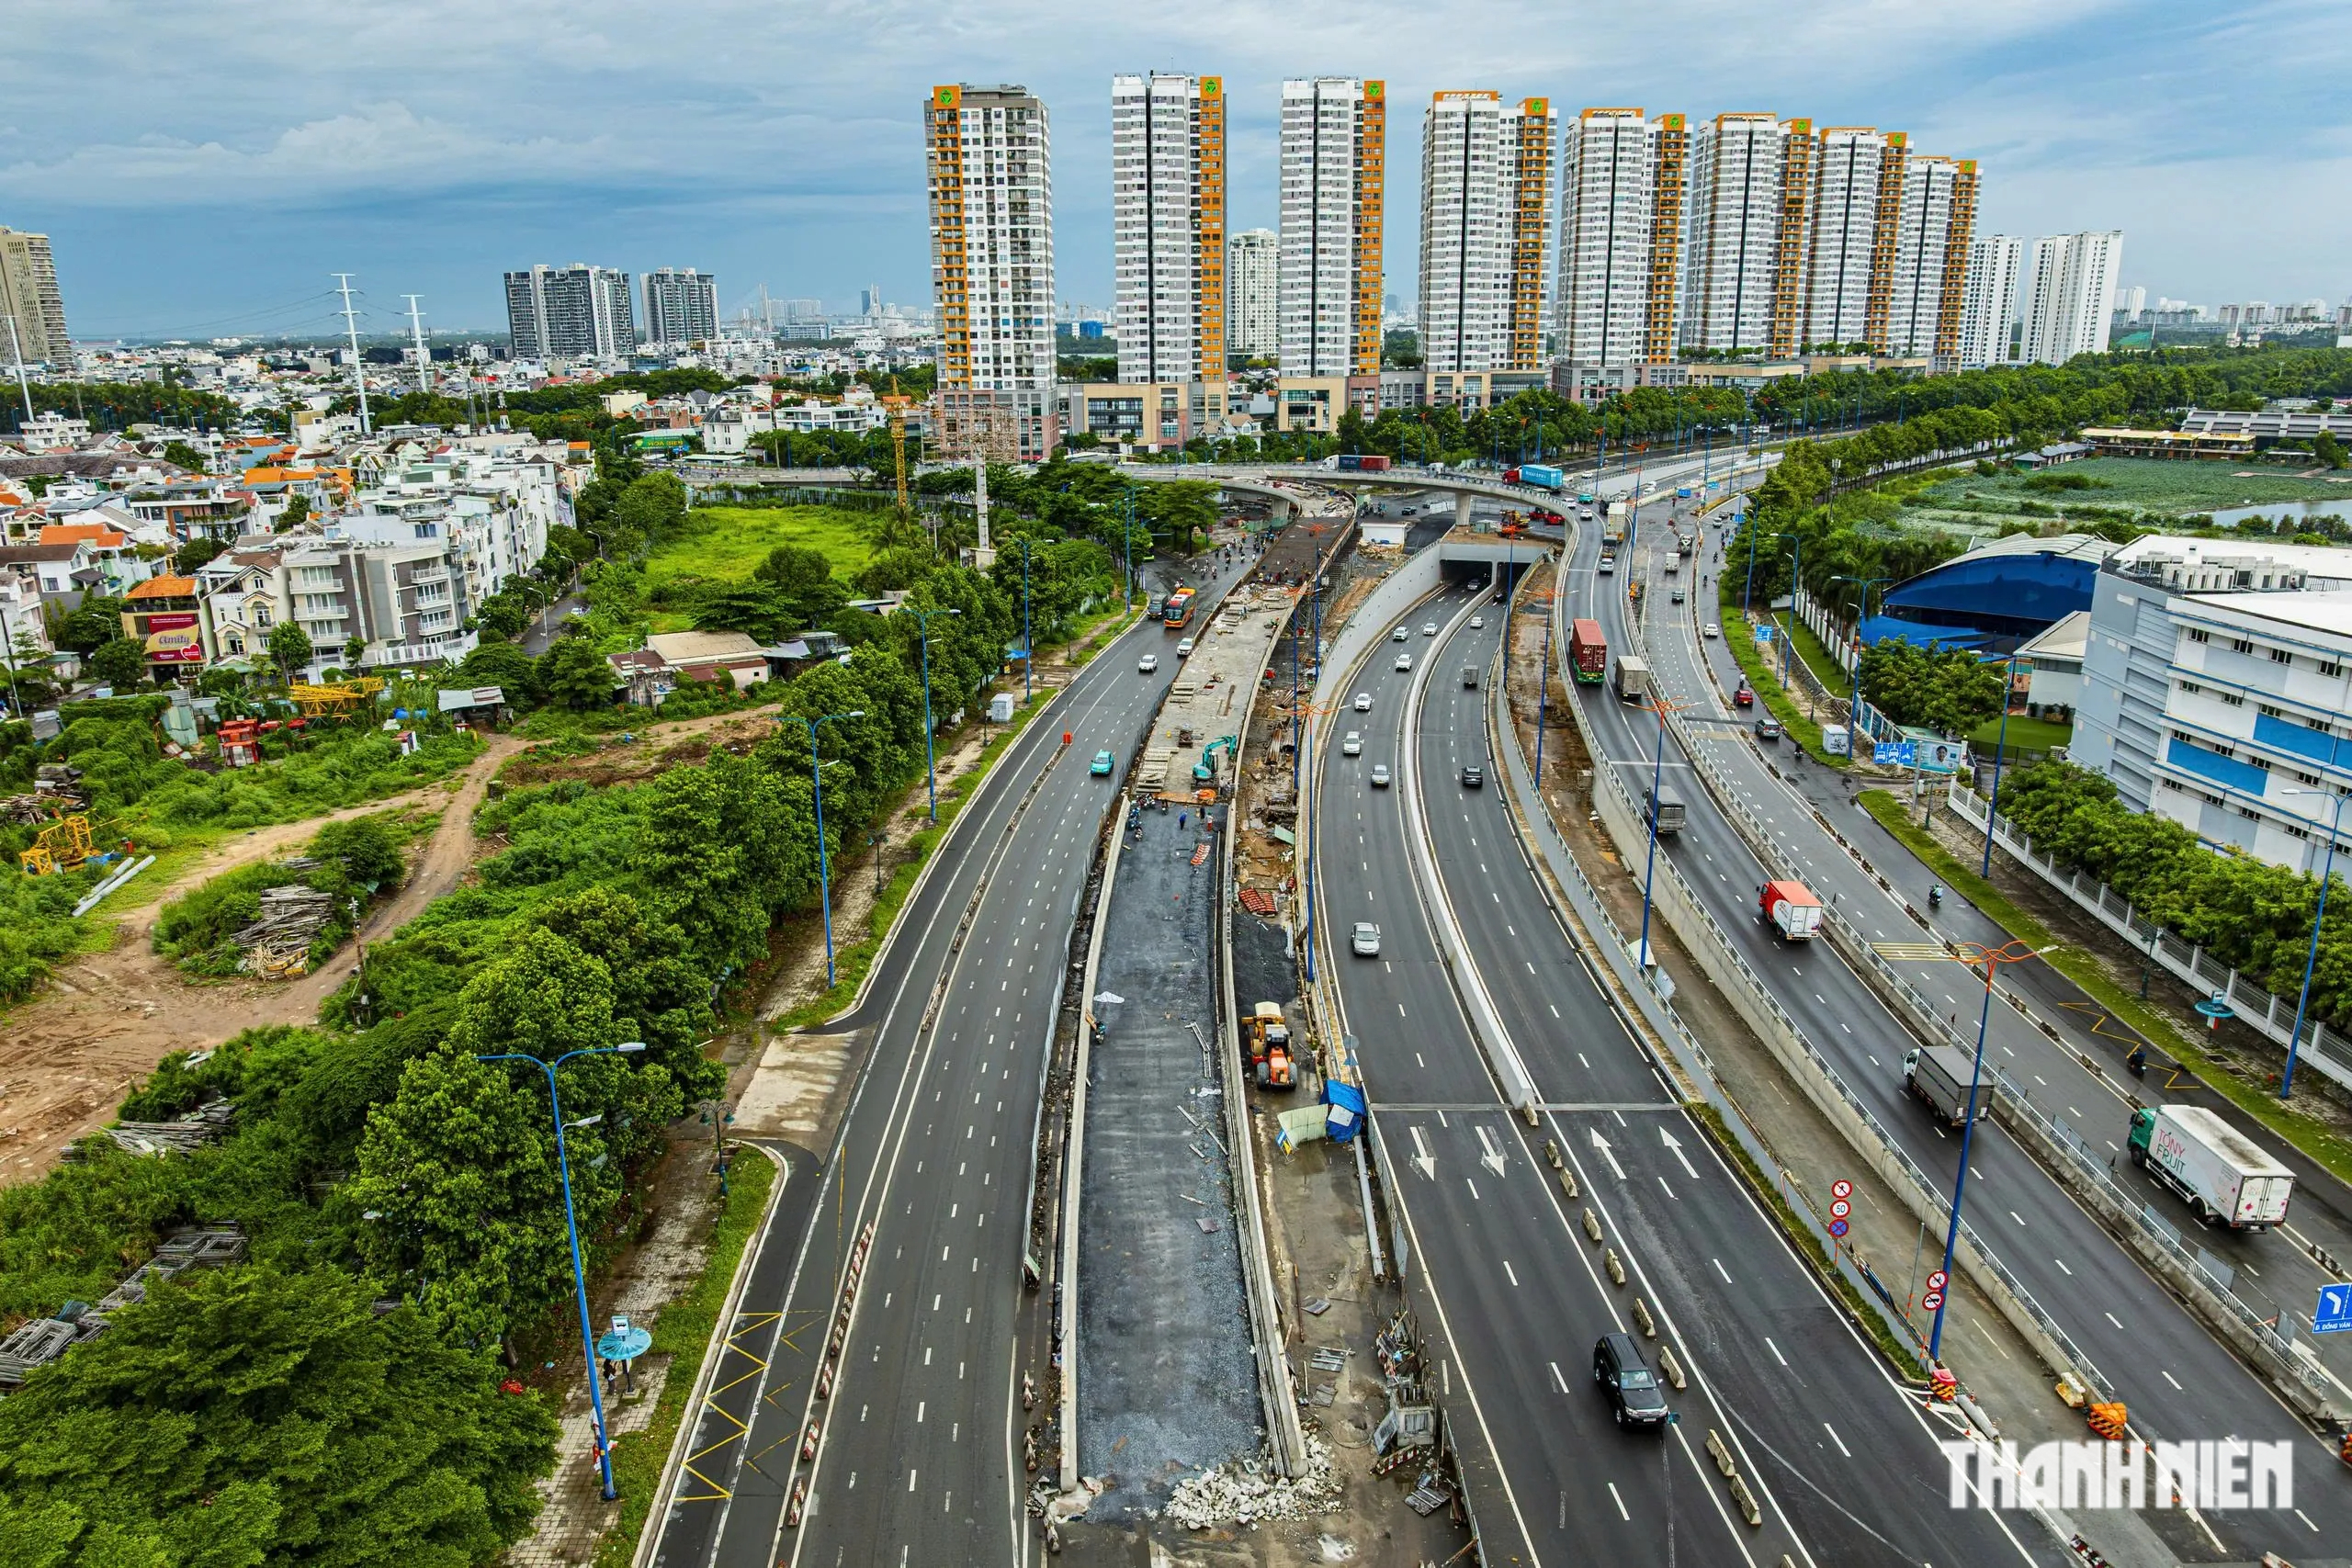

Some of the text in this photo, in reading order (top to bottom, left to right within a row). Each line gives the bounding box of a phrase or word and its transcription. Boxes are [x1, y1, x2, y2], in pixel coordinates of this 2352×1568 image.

[2159, 1129, 2186, 1158] TONY
[2156, 1143, 2186, 1175] FRUIT
[1837, 1204, 1846, 1213] 50
